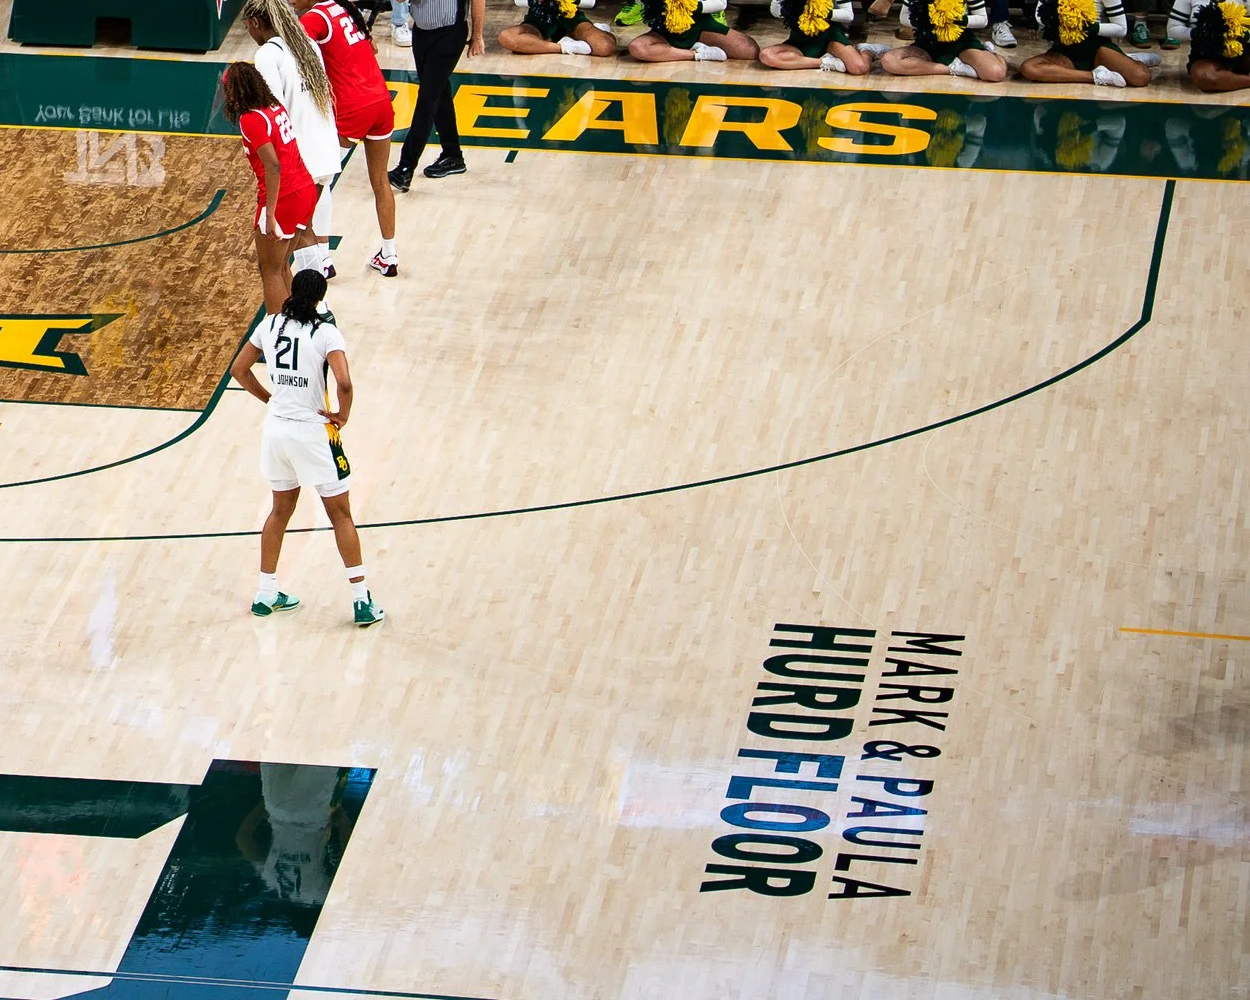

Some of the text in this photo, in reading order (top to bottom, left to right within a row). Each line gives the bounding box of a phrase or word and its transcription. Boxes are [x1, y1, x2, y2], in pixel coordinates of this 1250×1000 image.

[275, 336, 300, 371] 21
[277, 374, 309, 388] JOHNSON
[699, 622, 877, 897] HURD FLOOR
[827, 630, 965, 900] MARK & PAULA
